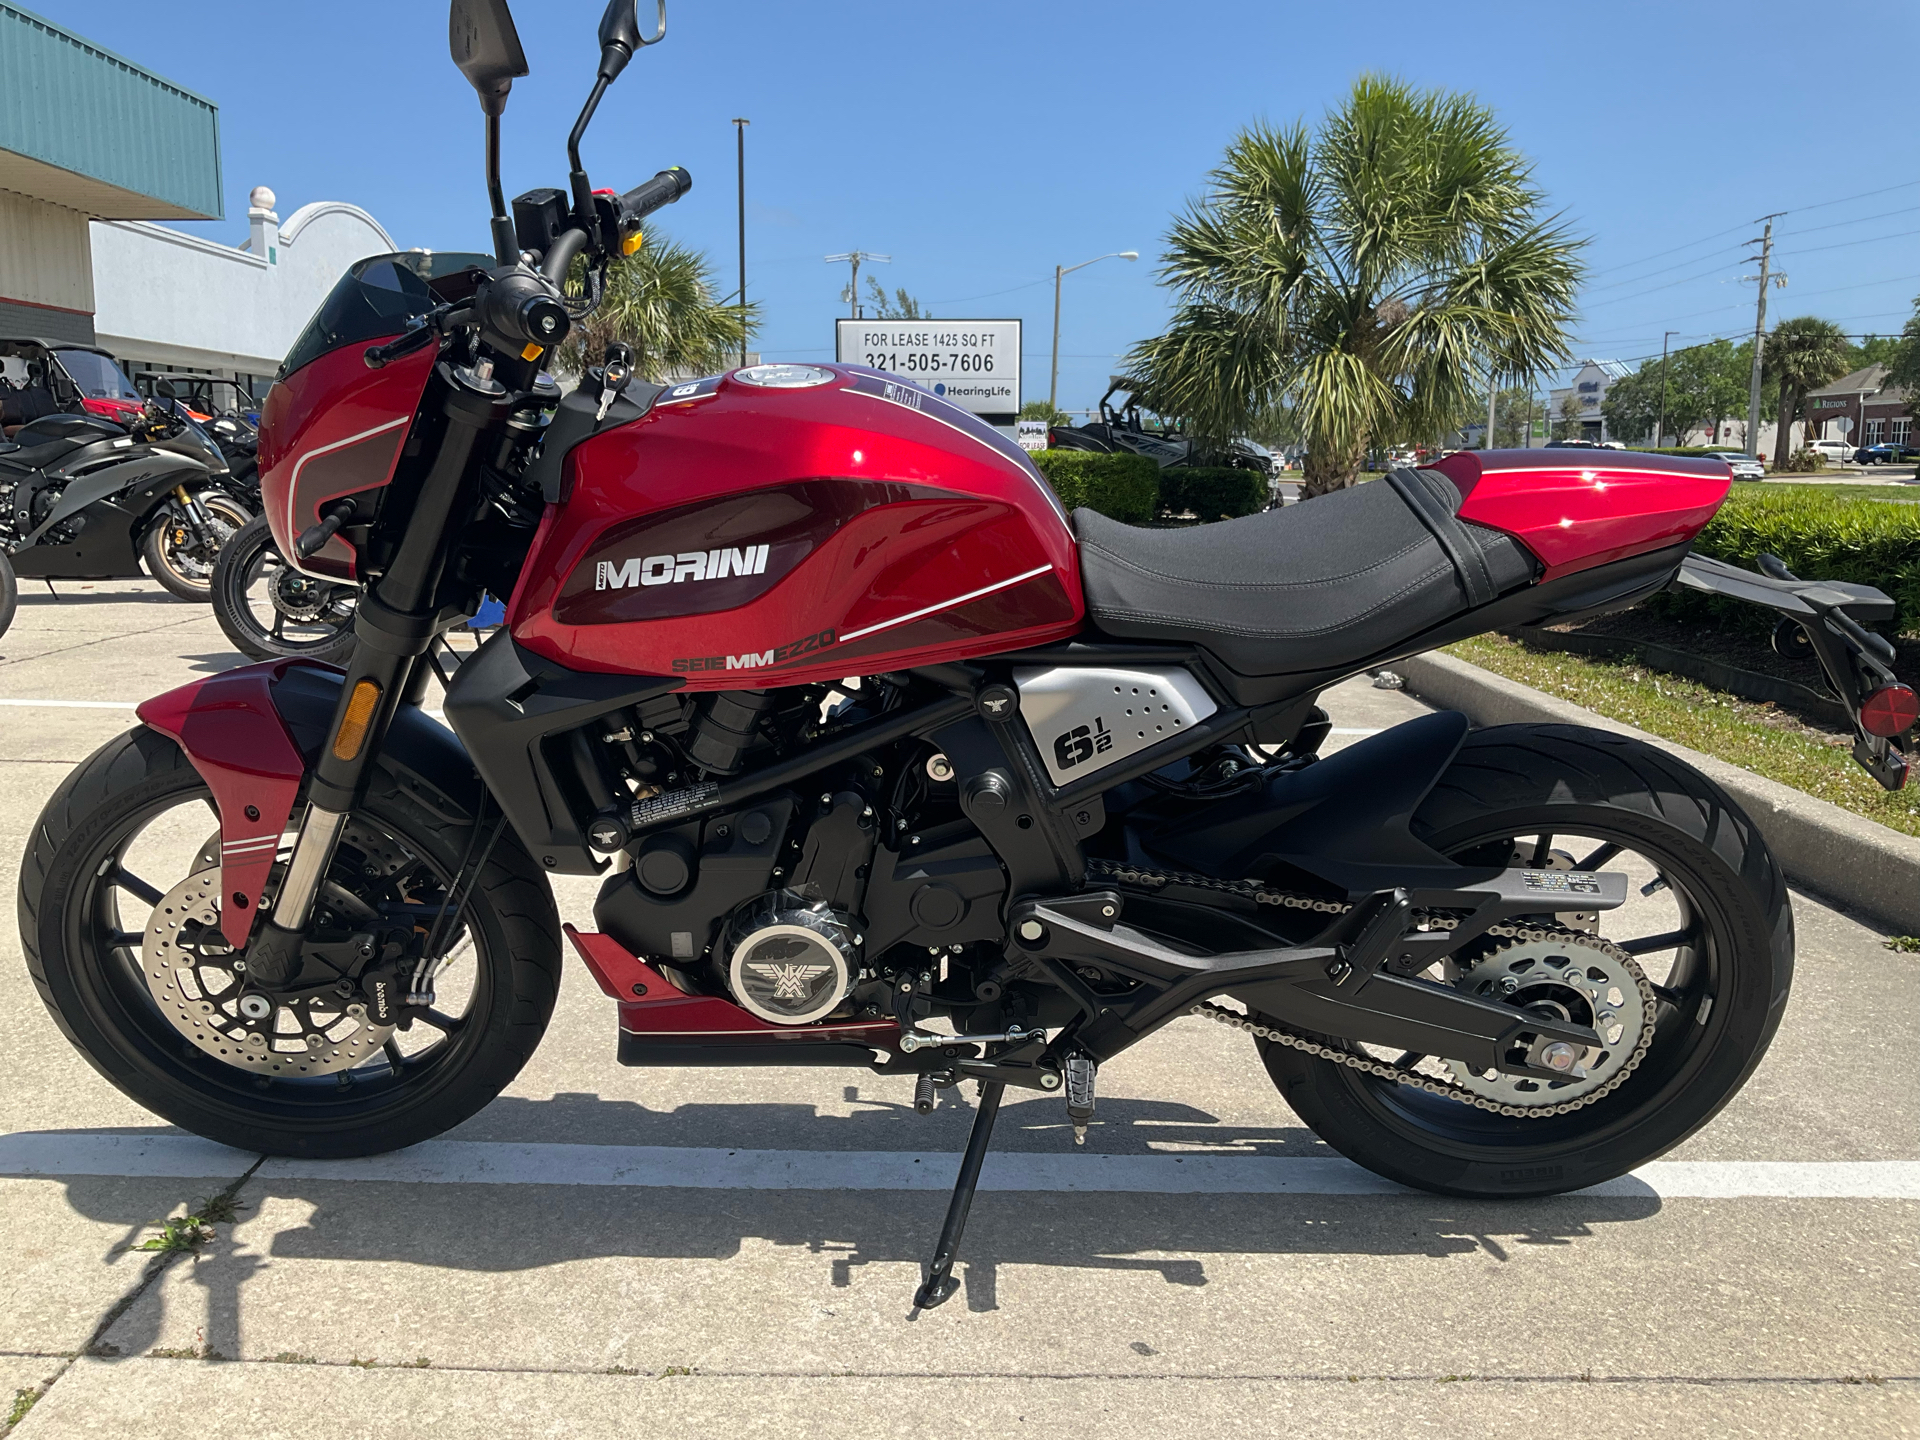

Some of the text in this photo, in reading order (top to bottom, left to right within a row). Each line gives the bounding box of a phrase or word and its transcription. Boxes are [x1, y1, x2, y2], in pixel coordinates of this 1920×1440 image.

[864, 333, 995, 348] FOR LEASE 1425 SQ FT
[865, 353, 994, 372] 321-505-7606
[947, 386, 1012, 398] HearingLife
[1031, 442, 1046, 450] LEASE
[124, 471, 153, 486] R6
[597, 562, 606, 589] MOTO
[606, 544, 770, 590] MORINI
[375, 982, 389, 1019] brembo
